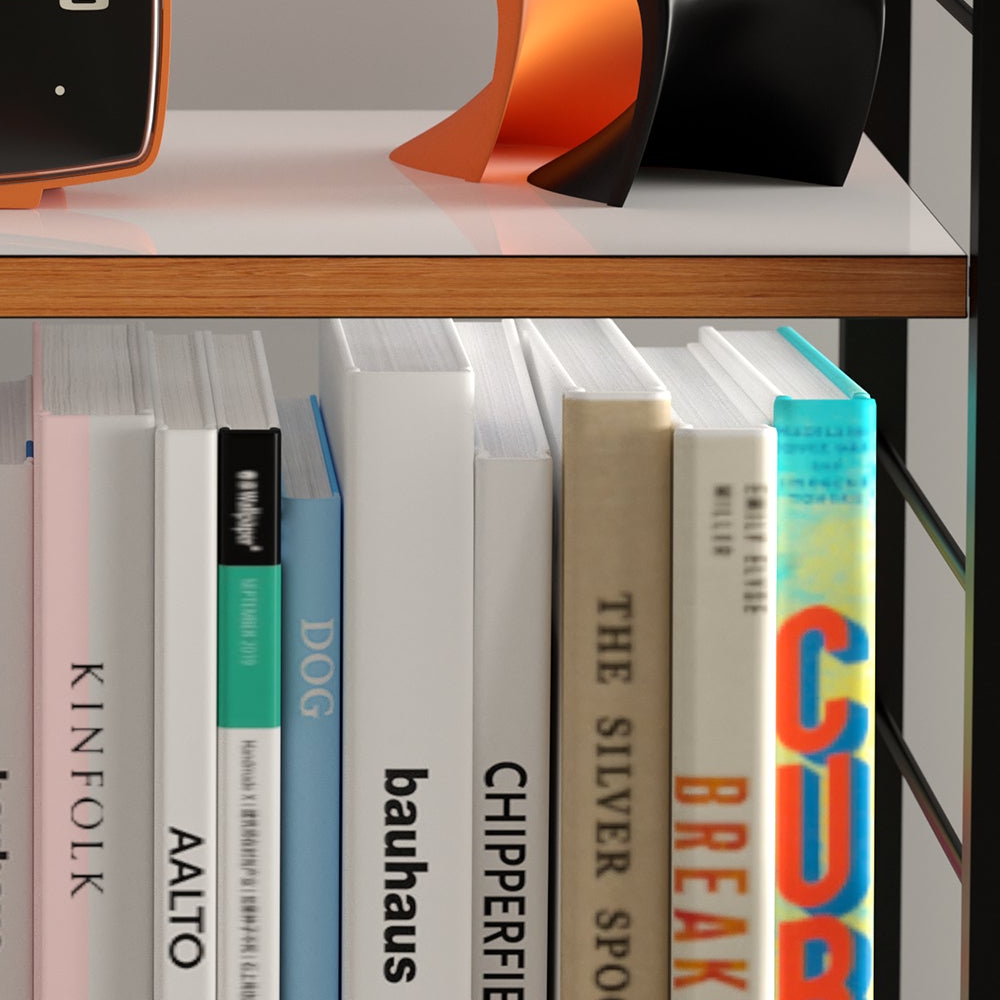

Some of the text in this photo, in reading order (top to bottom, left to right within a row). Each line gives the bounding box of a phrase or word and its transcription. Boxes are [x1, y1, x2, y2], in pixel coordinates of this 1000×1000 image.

[300, 618, 336, 719] DOG
[70, 662, 105, 899] KINFOLK
[383, 768, 429, 984] bauhaus
[594, 592, 633, 1000] THE SILVER SPO
[673, 775, 749, 992] BREAK
[168, 826, 206, 970] AALTO
